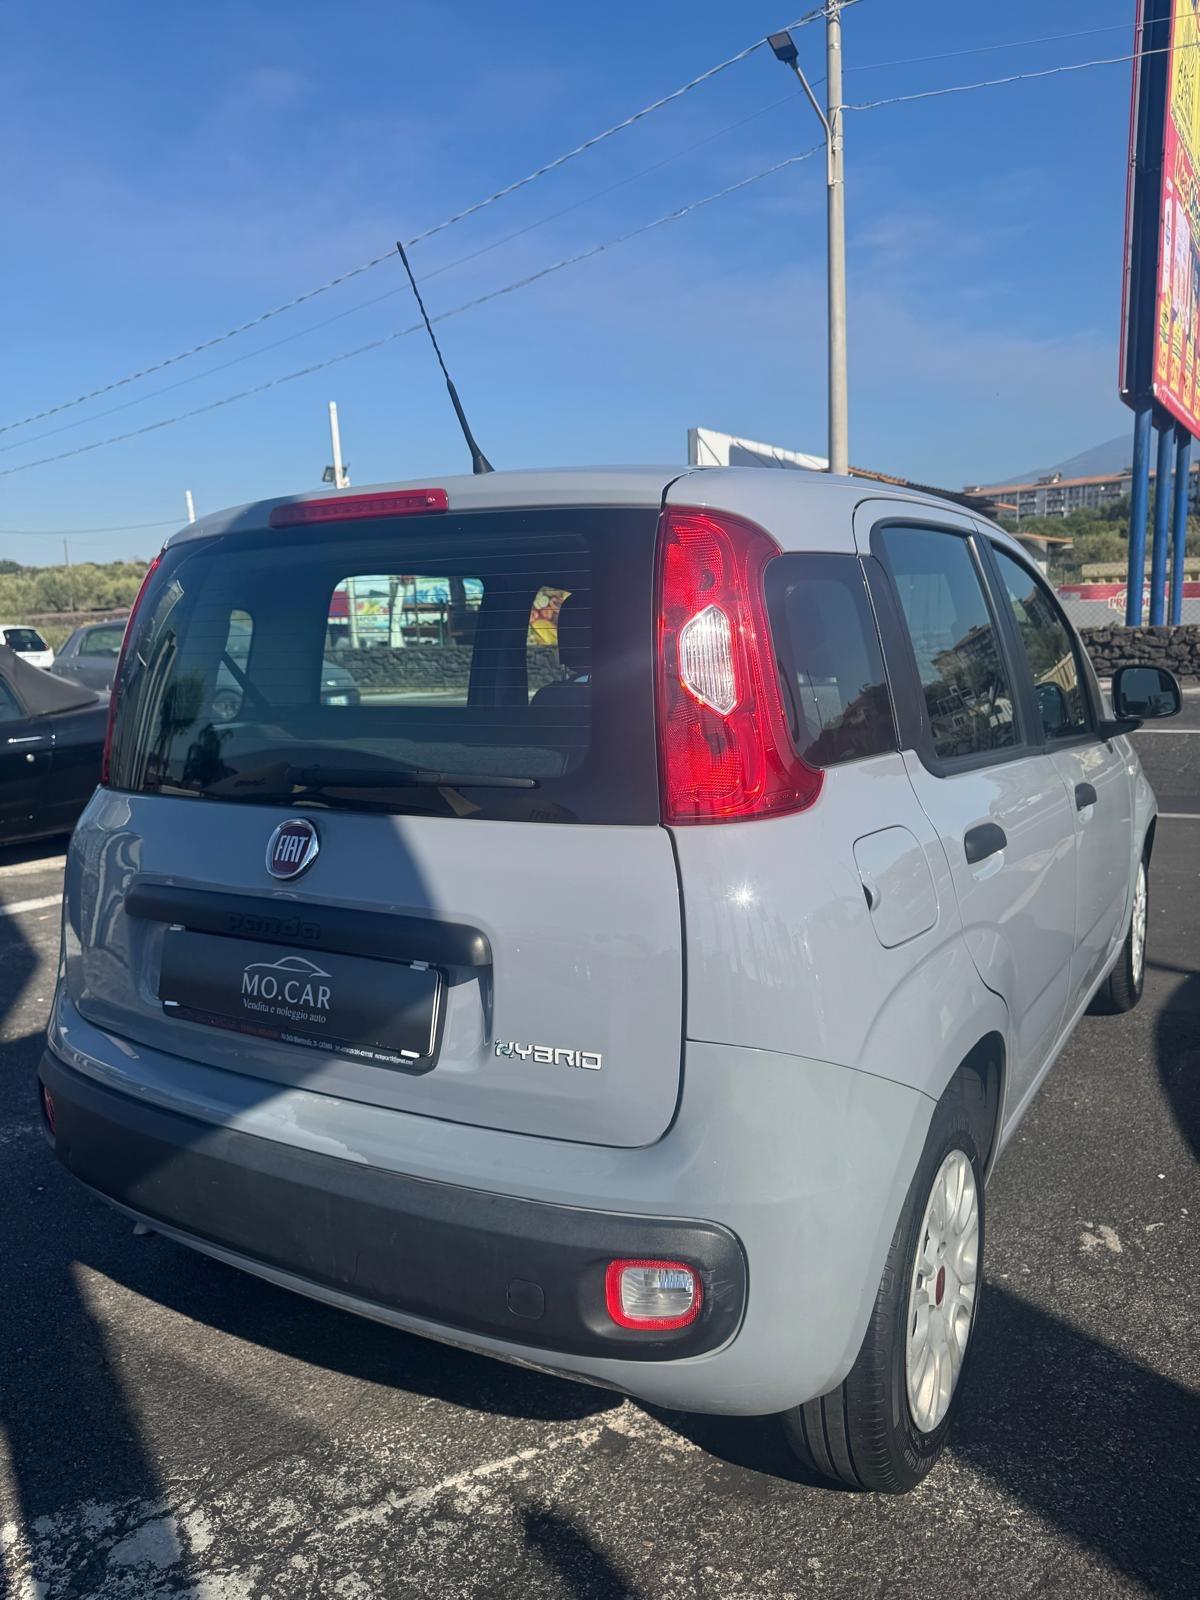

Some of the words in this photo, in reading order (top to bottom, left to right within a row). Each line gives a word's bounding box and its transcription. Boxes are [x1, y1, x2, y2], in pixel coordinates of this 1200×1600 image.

[274, 835, 309, 863] FIAT
[241, 972, 331, 1010] MO.CAR
[243, 998, 269, 1013] Vendita
[270, 1006, 276, 1014] e
[276, 1006, 308, 1021] noleggio
[309, 1013, 327, 1024] auto
[495, 1039, 603, 1071] HYBRID
